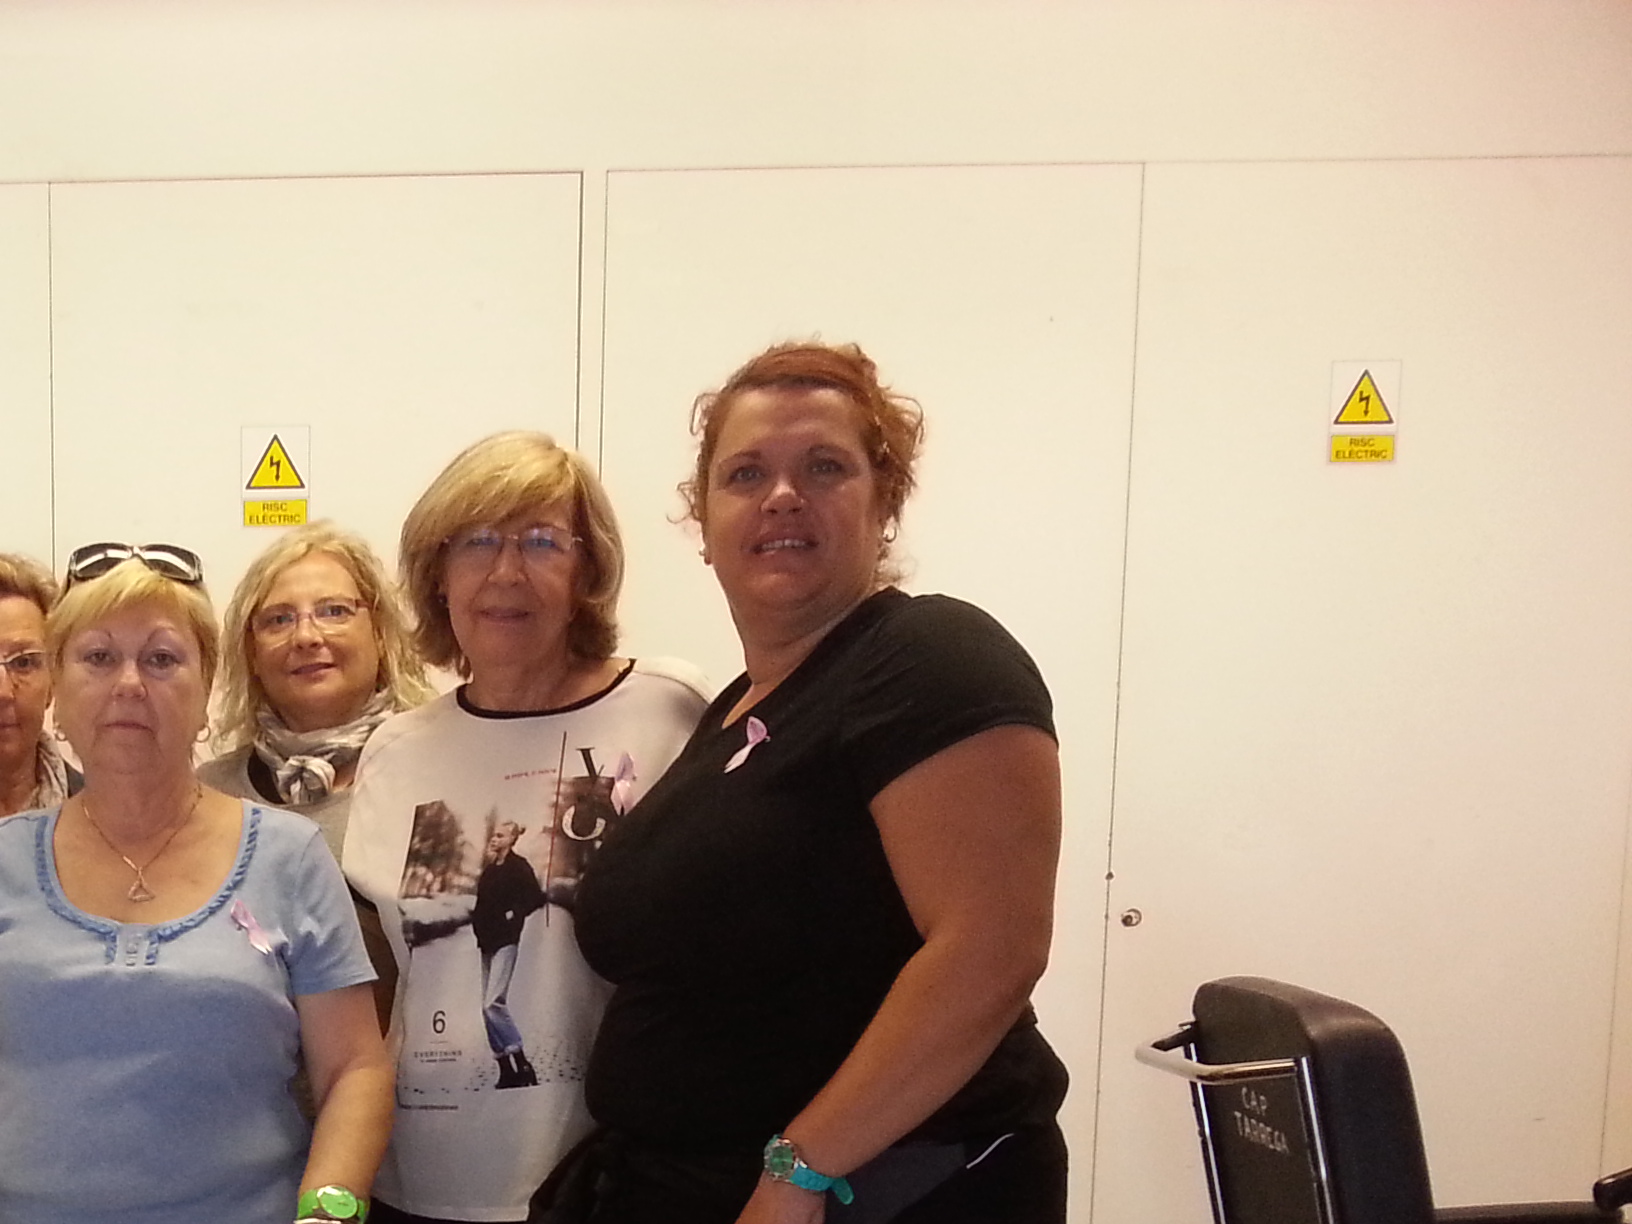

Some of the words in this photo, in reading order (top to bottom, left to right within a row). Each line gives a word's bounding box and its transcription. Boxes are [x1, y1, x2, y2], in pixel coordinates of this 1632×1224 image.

[1349, 437, 1375, 447] RISC
[262, 503, 288, 512] RISC
[432, 1010, 447, 1034] 6
[1241, 1086, 1268, 1117] CAP
[1234, 1110, 1290, 1154] TARREGA
